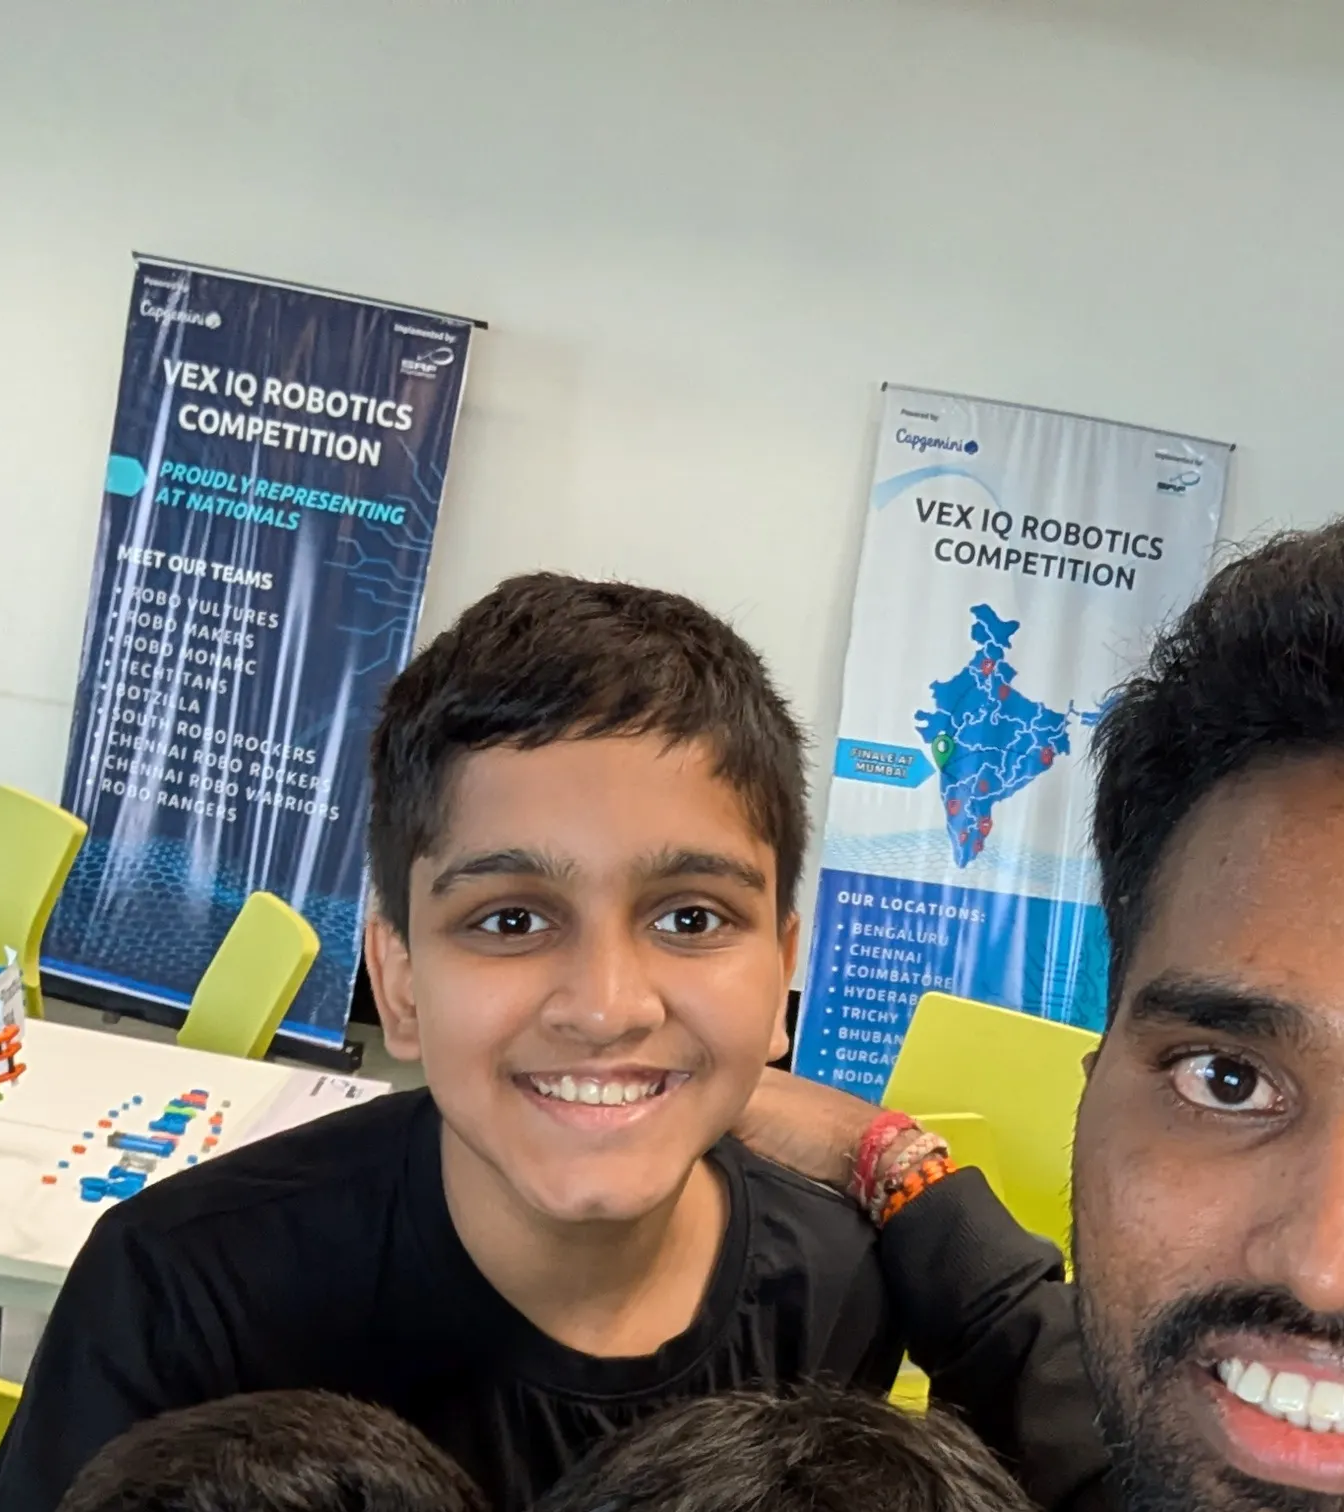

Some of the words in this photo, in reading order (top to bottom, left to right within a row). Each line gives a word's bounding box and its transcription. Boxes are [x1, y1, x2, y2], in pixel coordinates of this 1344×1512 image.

[163, 358, 219, 395] VEX
[225, 372, 258, 407] IQ
[264, 378, 413, 431] ROBOTICS
[178, 404, 381, 466] COMPETITION
[896, 428, 963, 453] Capgemini
[155, 487, 186, 506] AT
[186, 493, 301, 530] NATIONALS
[159, 460, 254, 494] PROUDLY
[255, 479, 406, 526] REPRESENTING
[916, 497, 976, 530] VEX
[981, 507, 1013, 541] IQ
[1021, 514, 1164, 560] ROBOTICS
[117, 544, 166, 568] MEET
[168, 555, 206, 577] OUR
[211, 562, 273, 590] TEAMS
[934, 537, 1137, 591] COMPETITION
[131, 587, 181, 608] ROBO
[188, 597, 279, 629] VULTURES
[126, 610, 177, 632] ROBO
[185, 622, 255, 649] MAKERS
[123, 634, 173, 656] ROBO
[182, 648, 256, 675] MONARC
[112, 707, 170, 731] SOUTH
[177, 721, 226, 744] ROBO
[233, 734, 316, 764] ROCKERS
[851, 747, 894, 763] FINALE
[898, 755, 914, 765] AT
[104, 755, 183, 784] CHENNAI
[189, 774, 239, 797] ROBO
[109, 731, 187, 760] CHENNAI
[193, 749, 242, 773] ROBO
[249, 762, 331, 793] ROCKERS
[856, 762, 907, 778] MUMBAI
[101, 778, 150, 801] ROBO
[157, 791, 237, 822] RANGERS
[837, 891, 874, 907] OUR
[880, 896, 987, 922] LOCATIONS:
[849, 944, 922, 963] CHENNAI
[852, 922, 949, 946] BENGALURU
[846, 965, 953, 990] COIMBATORE
[842, 1006, 899, 1024] TRICHY
[833, 1068, 884, 1085] NOIDA
